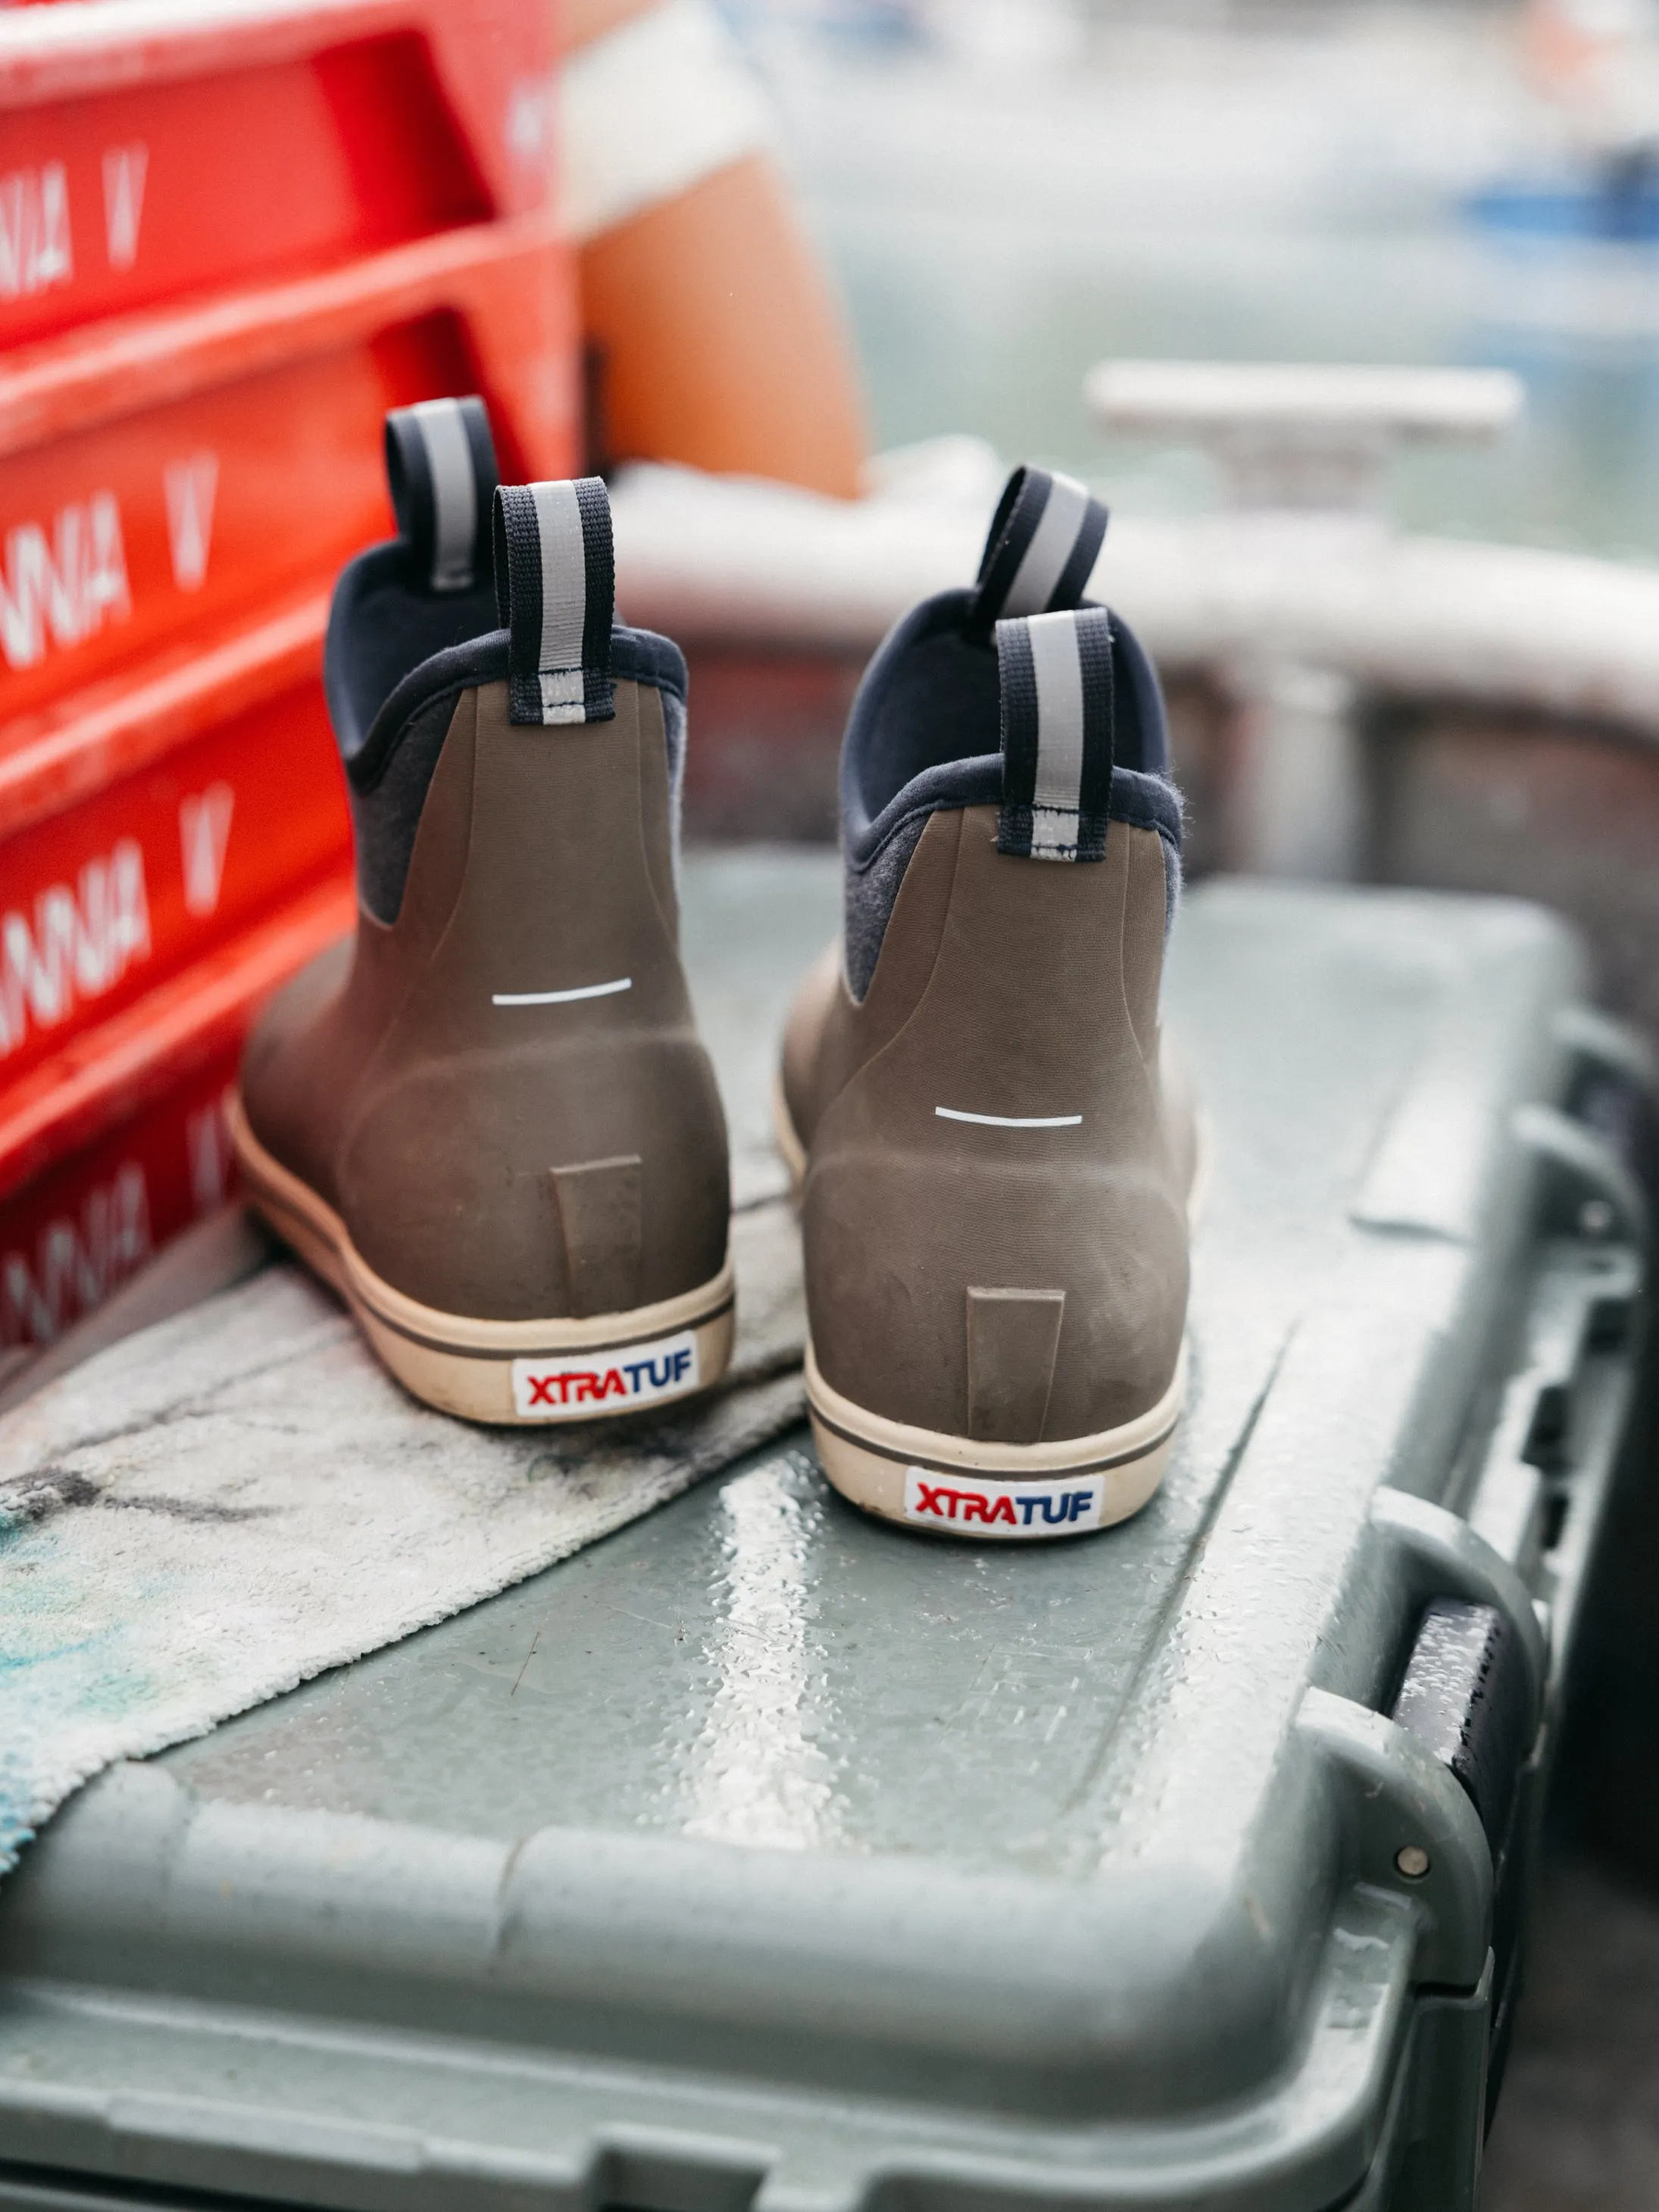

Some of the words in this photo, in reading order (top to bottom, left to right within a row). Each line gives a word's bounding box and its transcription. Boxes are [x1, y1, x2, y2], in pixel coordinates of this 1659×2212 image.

[162, 449, 218, 589] V
[180, 783, 234, 915] V
[527, 1348, 692, 1406] XTRATUF
[915, 1482, 1094, 1525] XTRATUF
